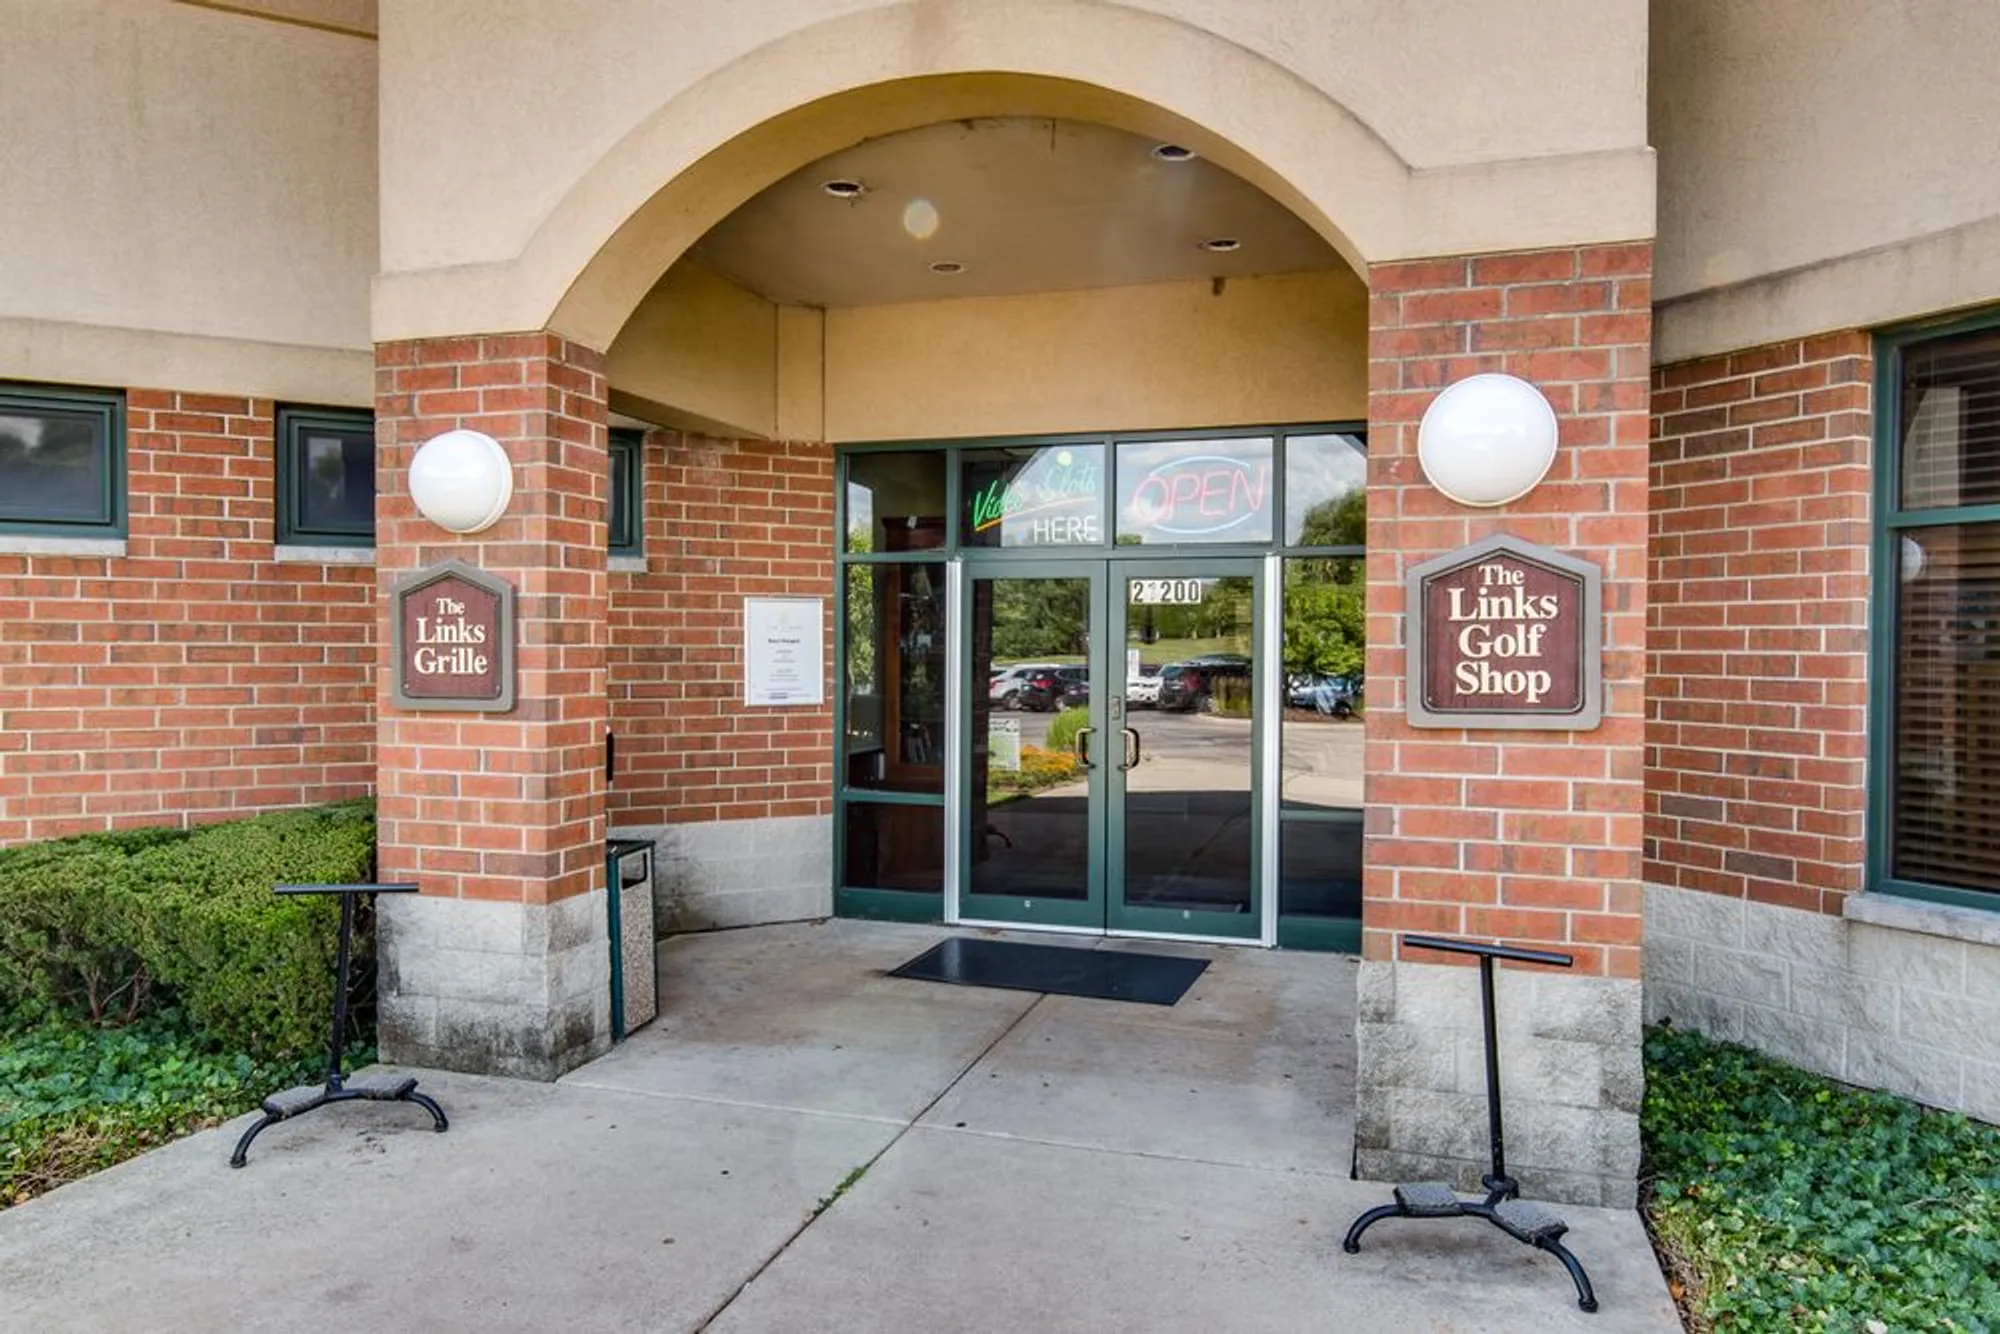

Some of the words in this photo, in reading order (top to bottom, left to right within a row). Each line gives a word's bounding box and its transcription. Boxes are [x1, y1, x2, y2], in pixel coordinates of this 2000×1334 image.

[1133, 466, 1265, 521] OPEN
[1033, 514, 1098, 544] HERE
[1479, 564, 1525, 585] The
[436, 598, 465, 614] The
[1447, 586, 1558, 621] Links
[416, 617, 486, 643] Links
[1458, 623, 1547, 658] Golf
[414, 647, 488, 675] Grille
[1455, 661, 1551, 703] Shop
